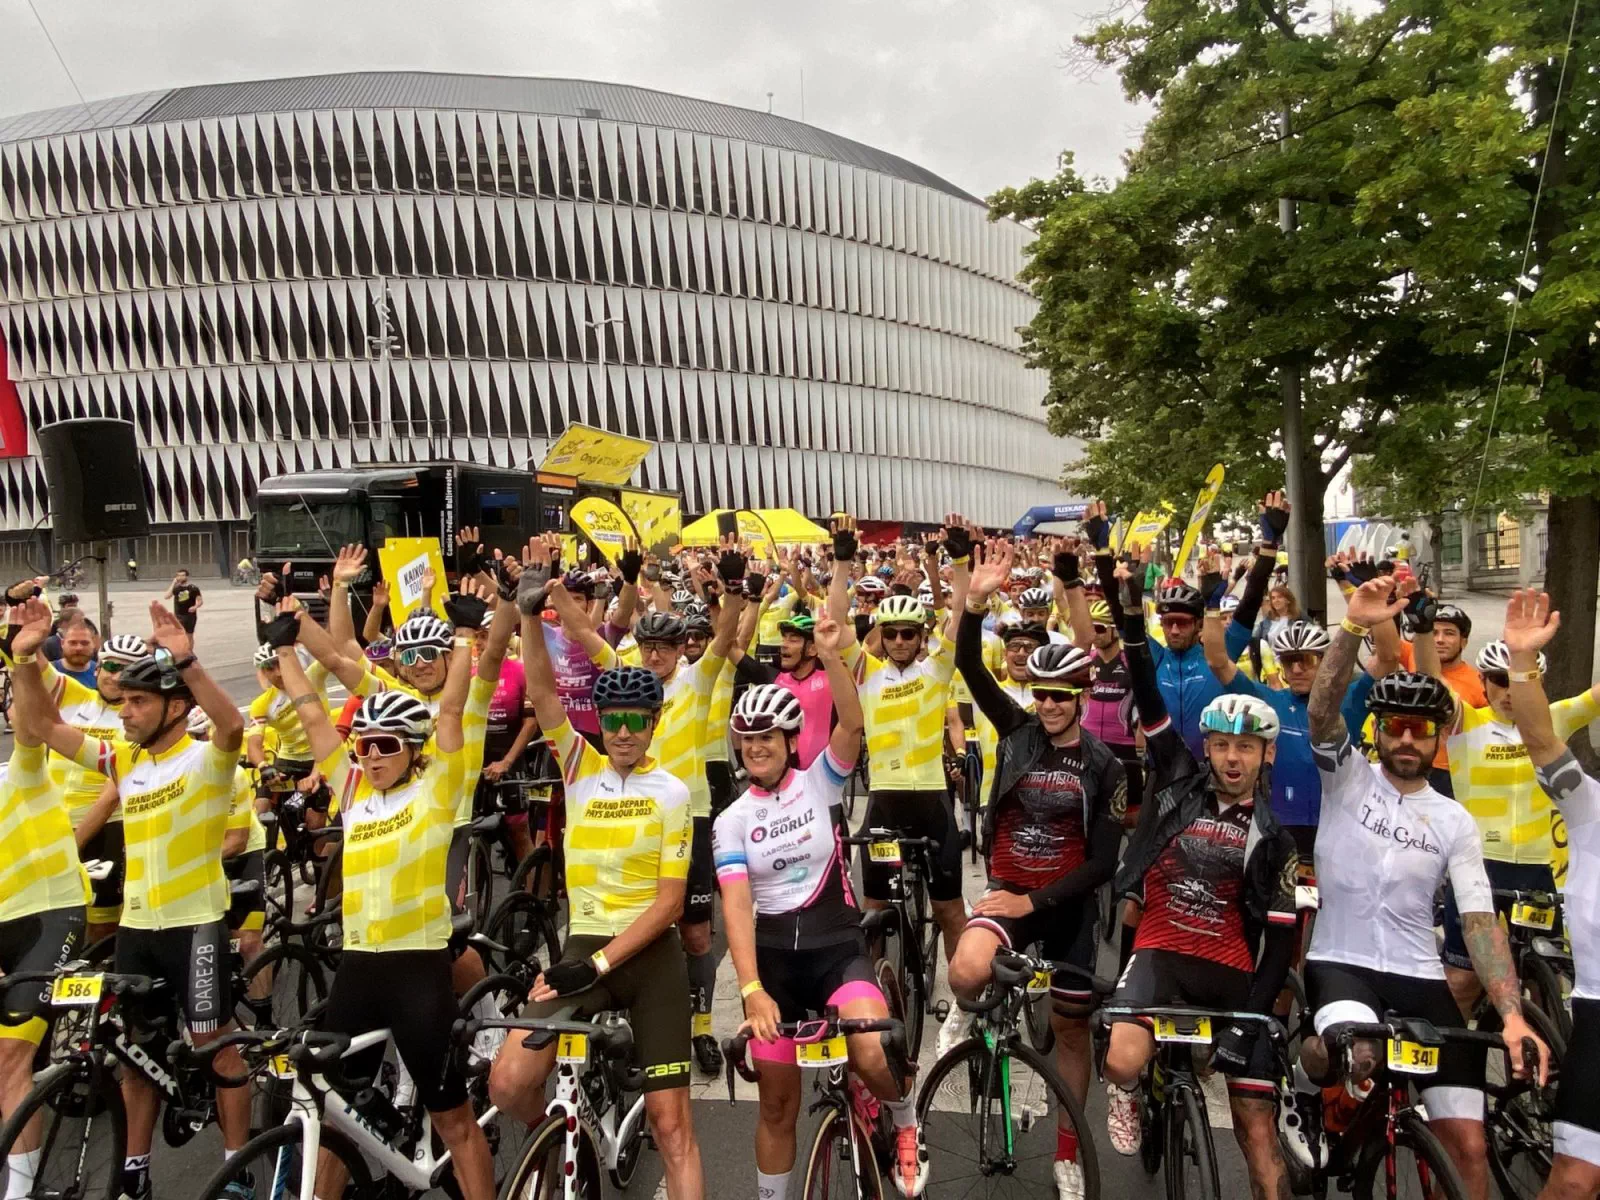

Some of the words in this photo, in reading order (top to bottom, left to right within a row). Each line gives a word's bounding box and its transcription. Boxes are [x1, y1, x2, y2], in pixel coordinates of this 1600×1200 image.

[127, 793, 151, 806] GRAND
[592, 801, 619, 809] GRAND
[585, 809, 604, 818] PAYS
[604, 809, 634, 819] BASQUE
[635, 808, 652, 817] 2023
[769, 808, 815, 839] GORLIZ
[1360, 804, 1391, 838] Life
[1393, 826, 1440, 855] Cycles
[762, 841, 797, 858] LABORAL
[875, 847, 896, 857] 1032
[1529, 910, 1547, 923] 443
[67, 983, 92, 997] 586
[565, 1041, 572, 1057] 1
[820, 1044, 831, 1059] 4
[115, 1032, 177, 1097] LOOK
[1411, 1049, 1433, 1066] 341
